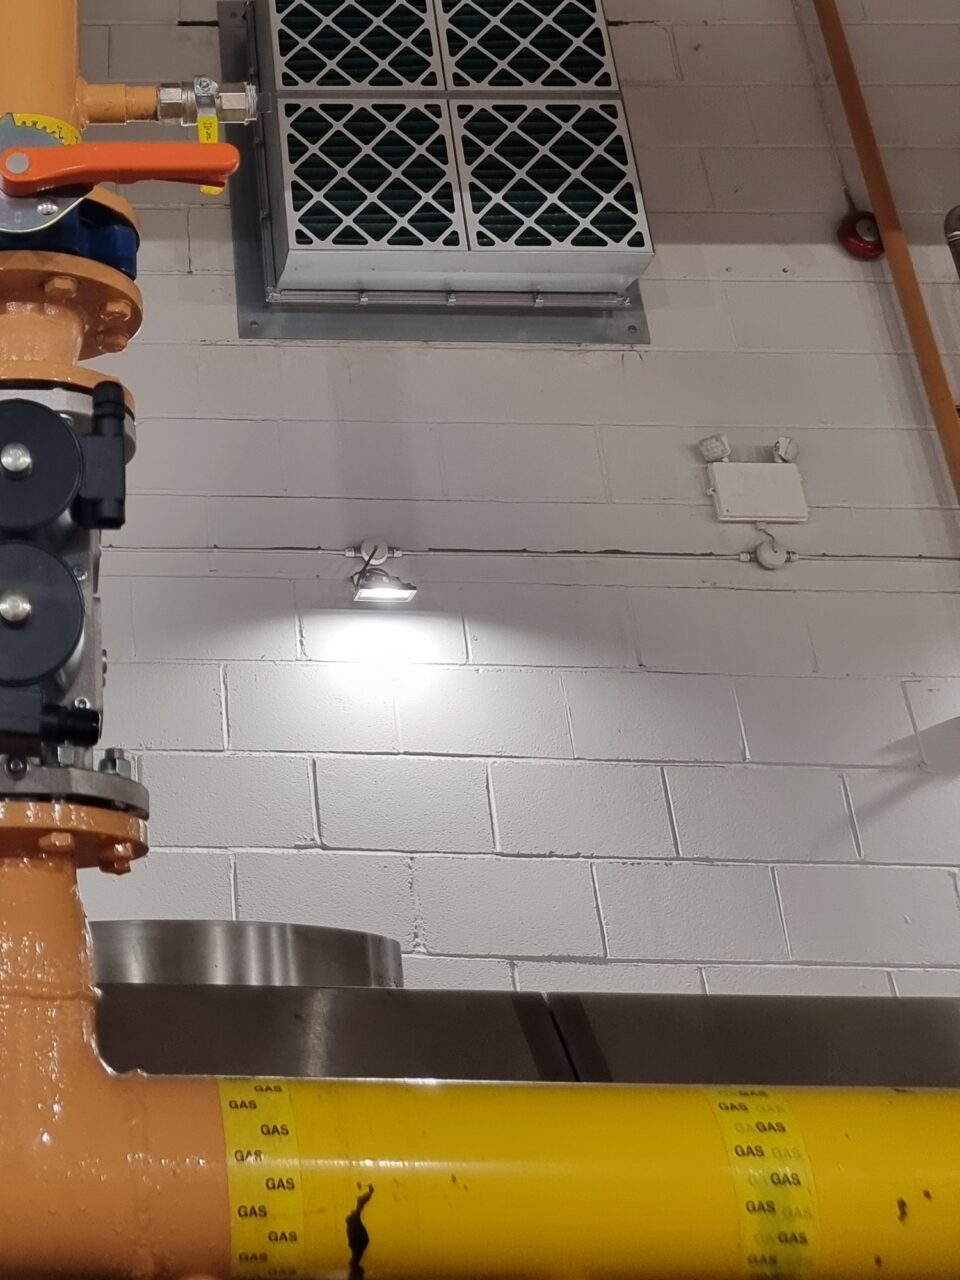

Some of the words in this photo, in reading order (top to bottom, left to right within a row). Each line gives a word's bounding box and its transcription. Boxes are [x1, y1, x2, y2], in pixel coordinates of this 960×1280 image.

[254, 1085, 282, 1093] GAS
[228, 1100, 257, 1110] GAS
[718, 1102, 748, 1111] GAS
[260, 1124, 290, 1136] GAS
[755, 1121, 786, 1133] GAS
[234, 1150, 263, 1163] GAS
[734, 1145, 765, 1157] GAS
[266, 1178, 295, 1190] GAS
[770, 1172, 801, 1186] GAS
[238, 1205, 267, 1218] GAS
[745, 1200, 776, 1213] GAS
[268, 1231, 298, 1242] GAS
[778, 1232, 808, 1244] GAS
[238, 1252, 268, 1262] GAS
[747, 1254, 778, 1265] GAS
